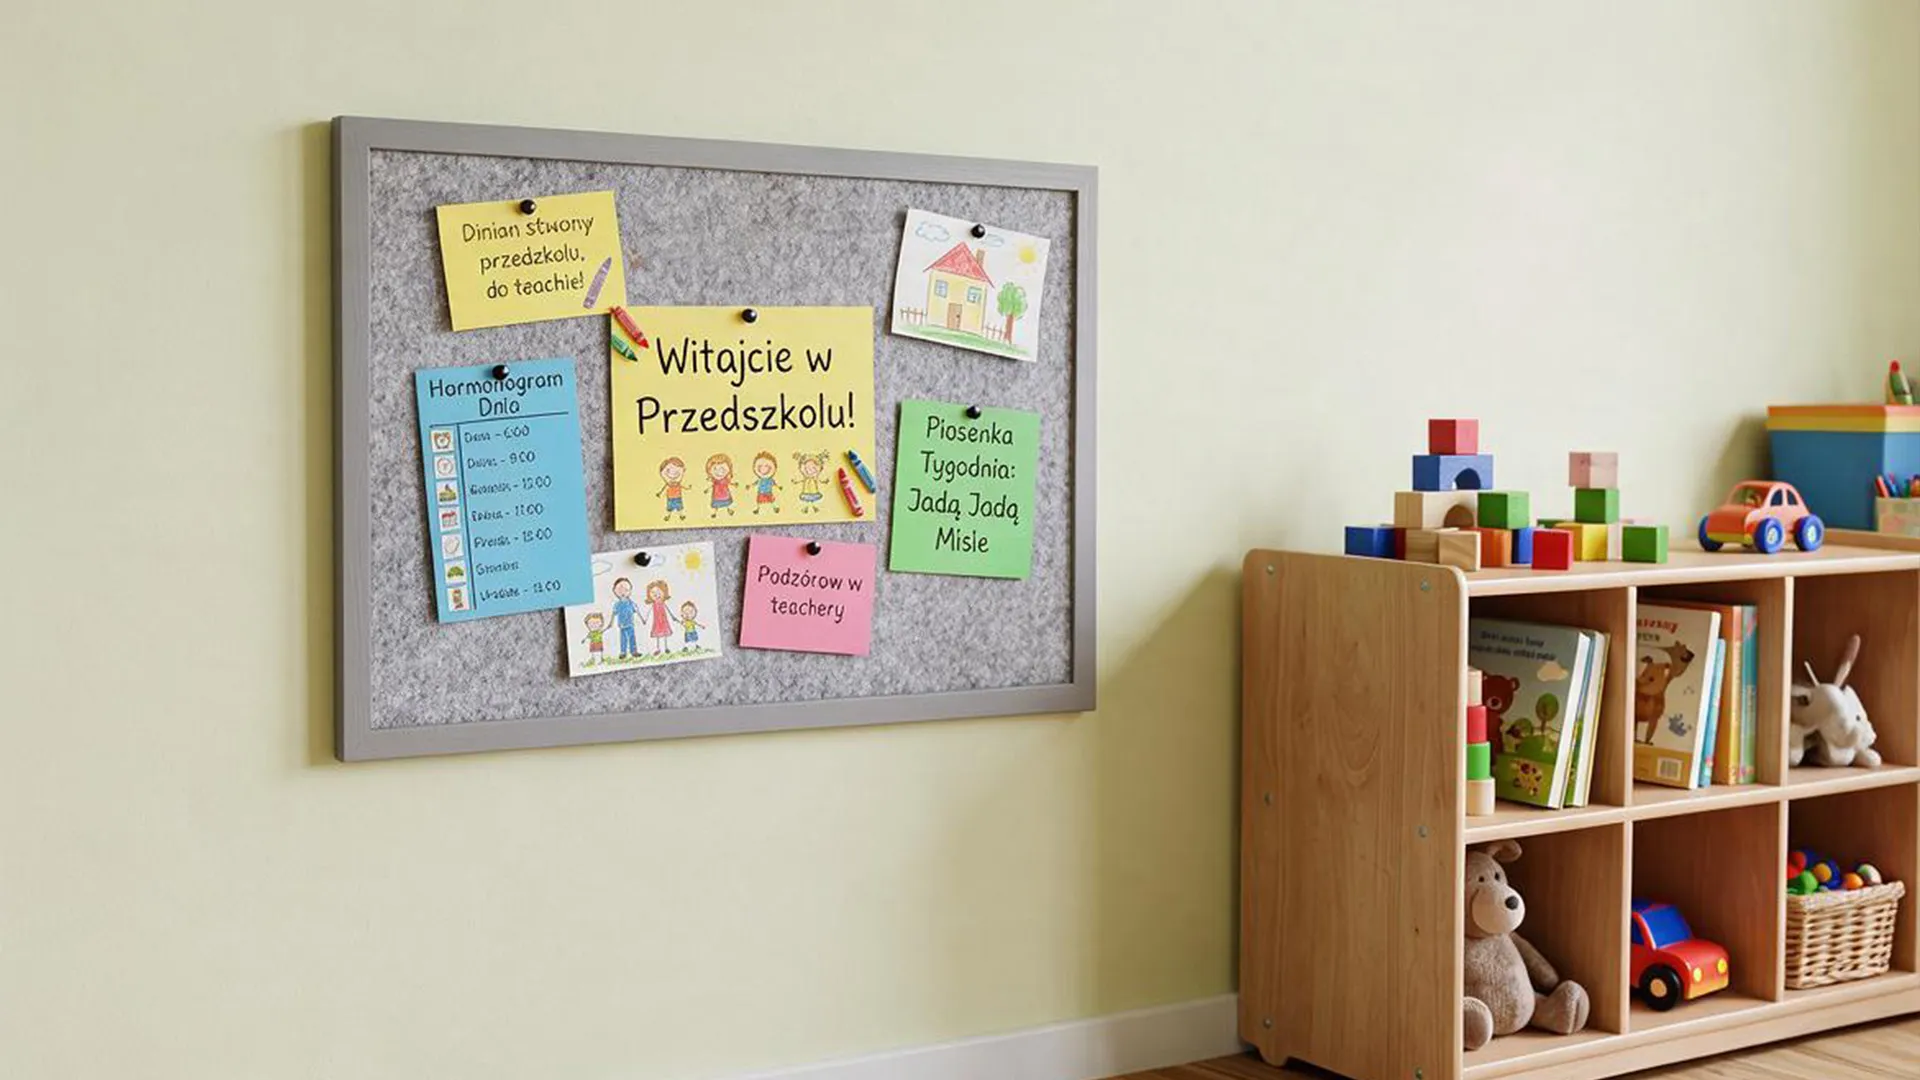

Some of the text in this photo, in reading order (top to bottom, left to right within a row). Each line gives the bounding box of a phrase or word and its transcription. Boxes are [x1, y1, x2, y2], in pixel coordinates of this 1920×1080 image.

[462, 223, 520, 242] Dinian
[487, 280, 509, 299] do
[656, 337, 832, 388] Witajcie w
[636, 391, 855, 435] Przedszkolu!
[926, 415, 1014, 445] Piosenka
[920, 450, 1016, 484] Tygodnia:
[907, 487, 961, 521] Jadą
[848, 578, 863, 592] w
[770, 596, 845, 624] teachery
